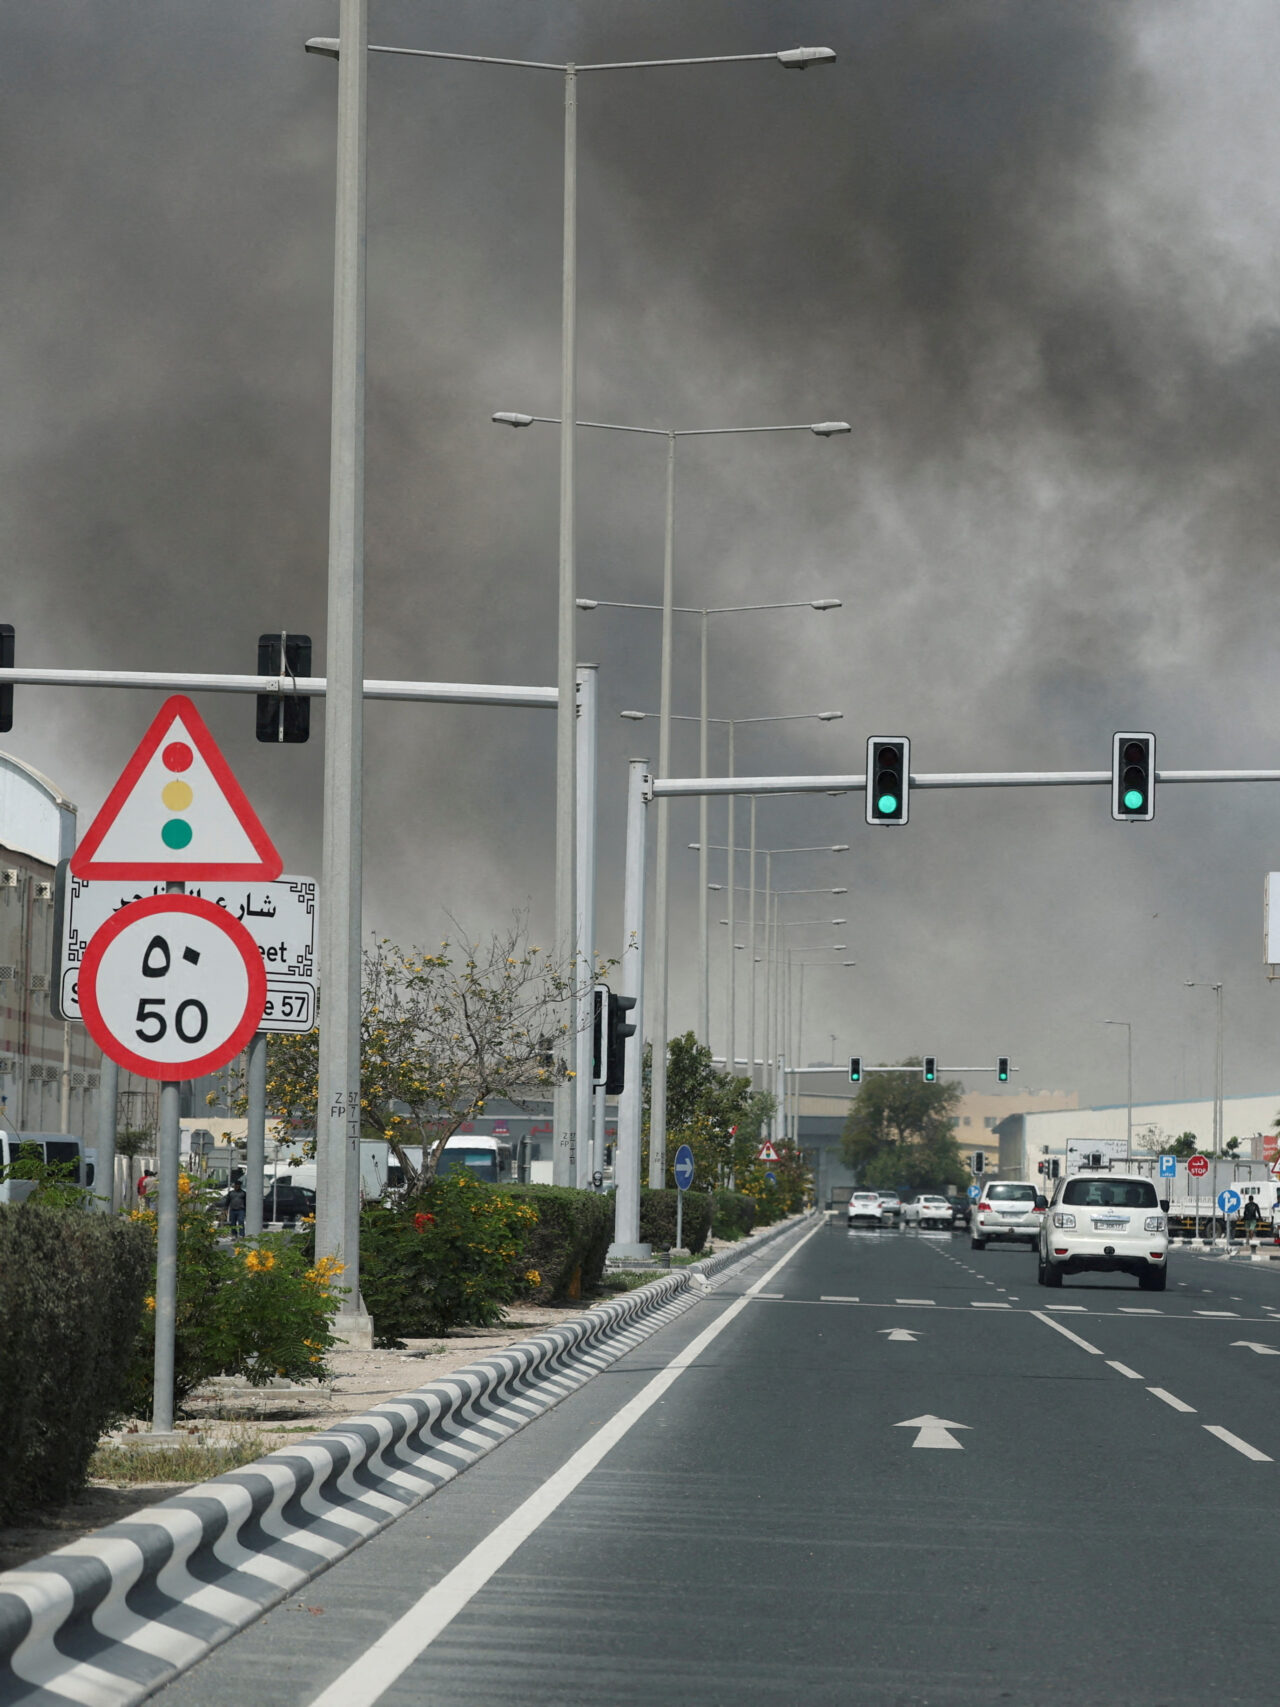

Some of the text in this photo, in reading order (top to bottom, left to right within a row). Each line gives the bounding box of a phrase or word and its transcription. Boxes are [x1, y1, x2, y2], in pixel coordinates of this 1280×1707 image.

[142, 935, 201, 978] ٥٠
[281, 995, 306, 1018] 57
[135, 998, 209, 1044] 50
[335, 1092, 358, 1104] Z 57
[330, 1105, 346, 1118] FP
[1162, 1156, 1173, 1171] P
